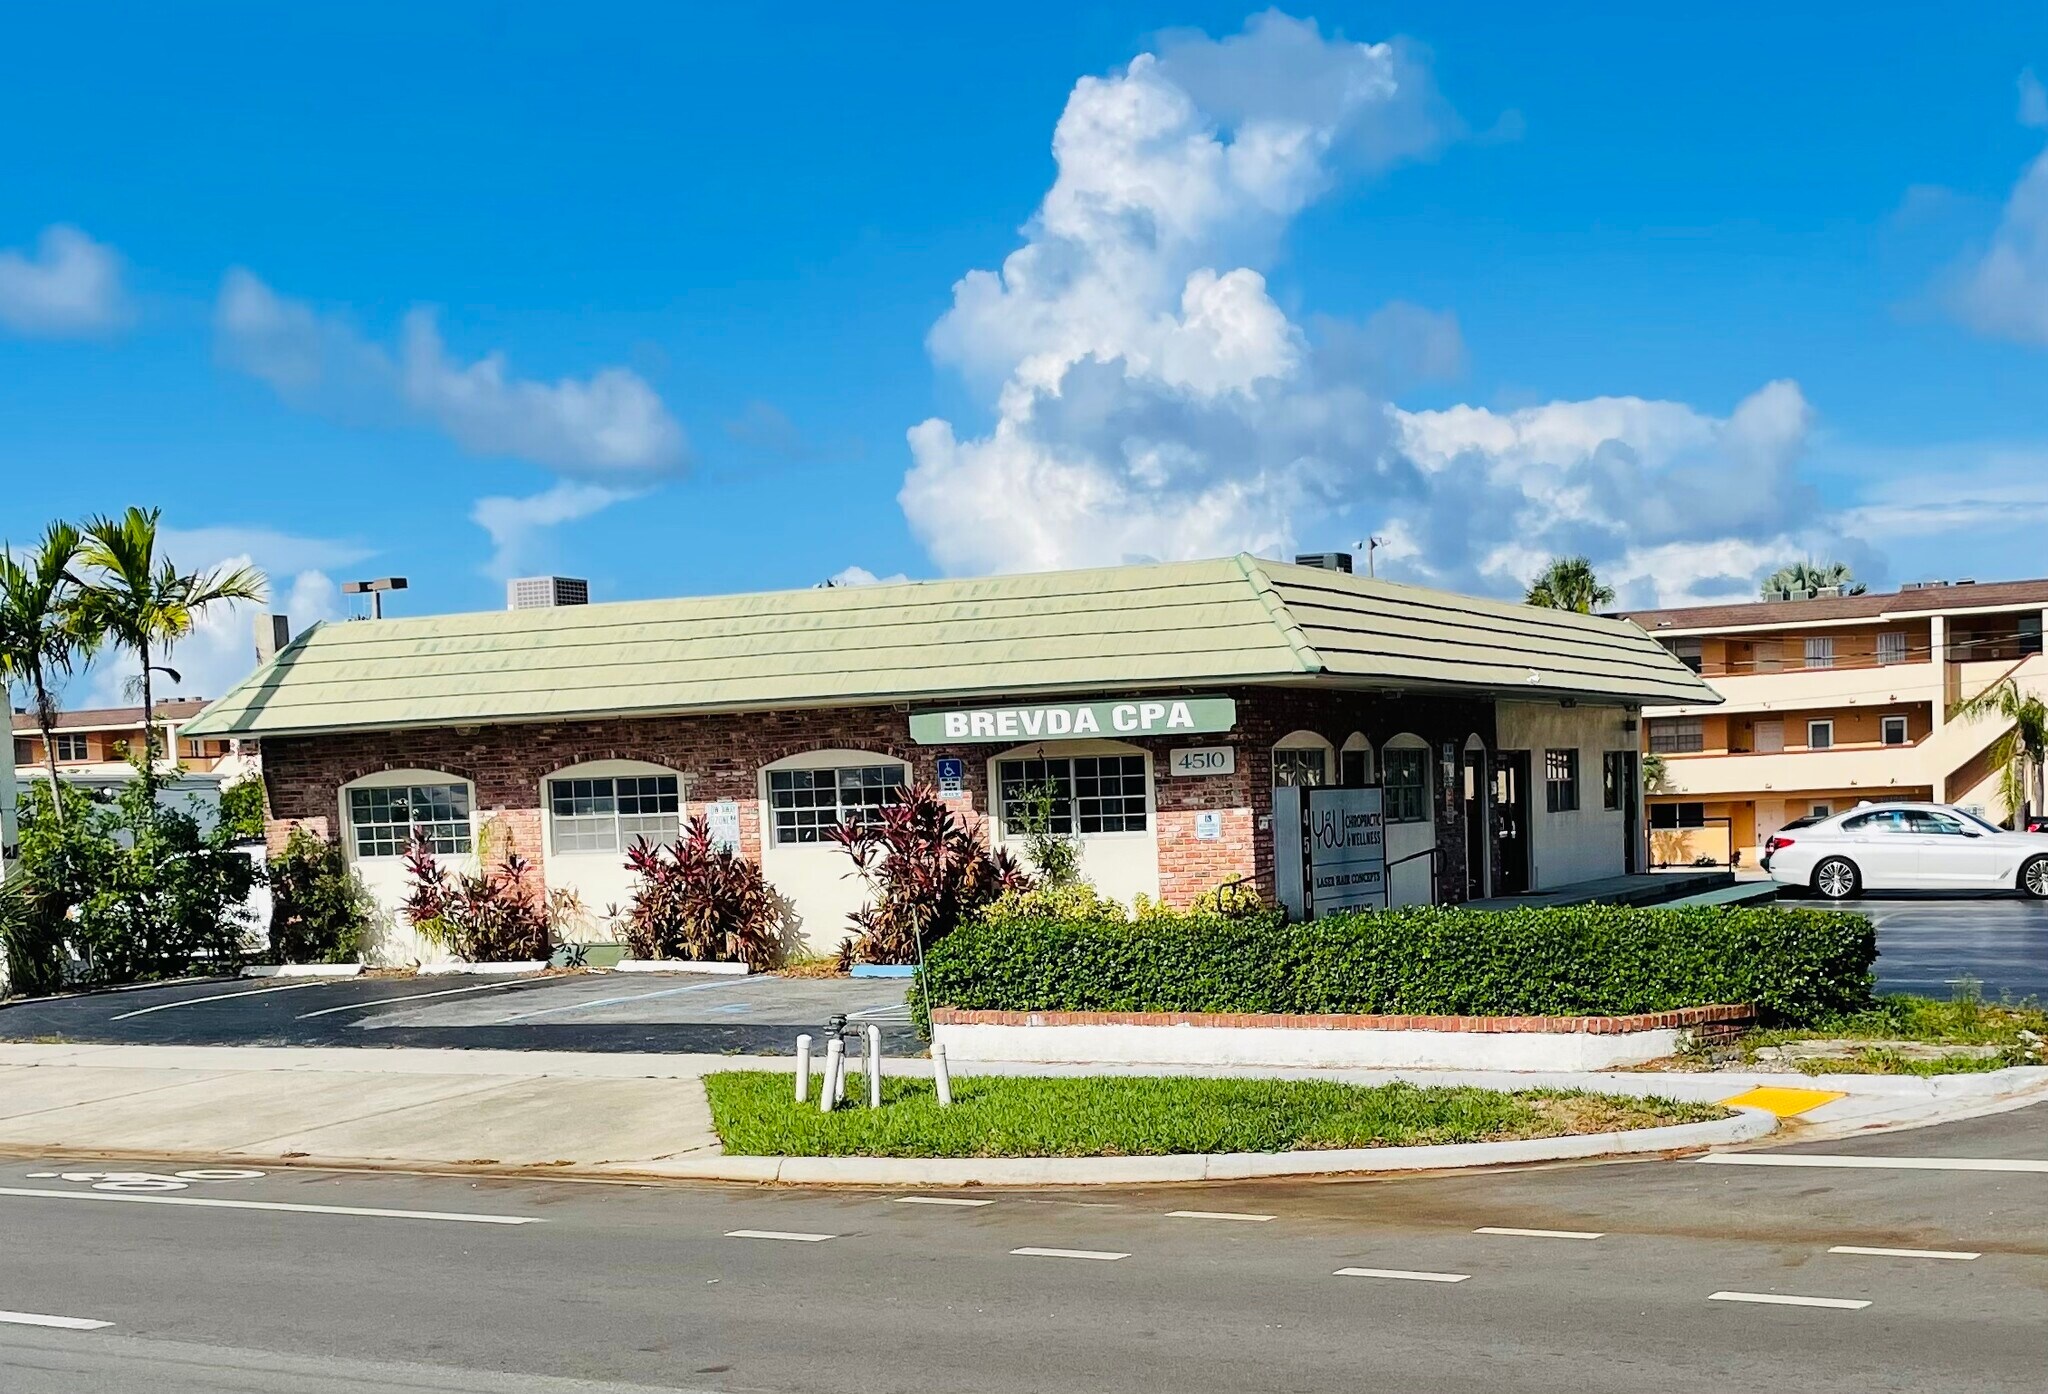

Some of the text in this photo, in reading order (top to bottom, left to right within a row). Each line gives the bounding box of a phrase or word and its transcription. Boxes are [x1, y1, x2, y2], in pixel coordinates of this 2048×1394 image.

[945, 701, 1195, 738] BREVDA CPA
[1178, 752, 1225, 769] 4510
[1345, 813, 1382, 828] CHIROPRACTIC
[1351, 831, 1381, 847] WELLNESS
[1316, 871, 1381, 889] LASER HAIR CONCEPTS
